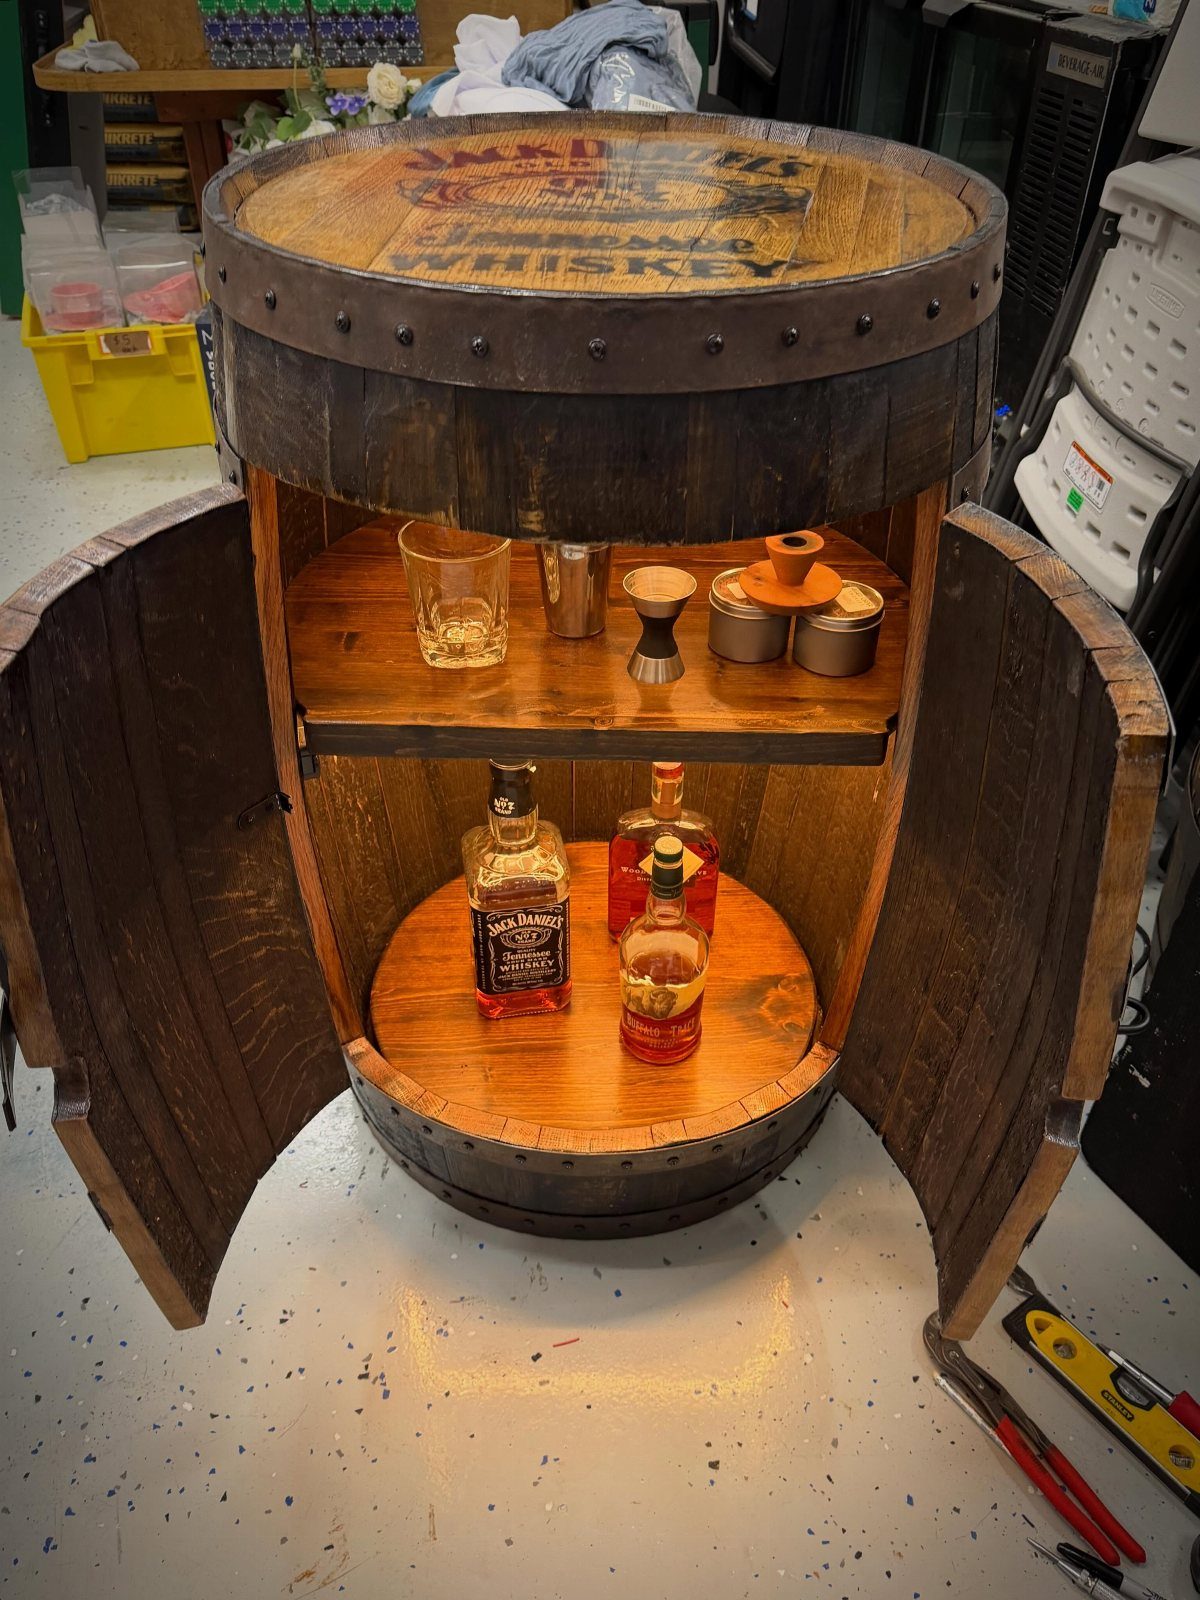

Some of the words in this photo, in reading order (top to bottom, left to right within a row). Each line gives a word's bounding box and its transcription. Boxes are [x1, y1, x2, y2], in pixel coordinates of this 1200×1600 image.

[404, 143, 566, 171] JACK
[389, 253, 790, 277] WHISKEY
[487, 916, 518, 937] JACK
[517, 913, 564, 930] DANIEL'S
[500, 959, 555, 972] WHISKEY
[502, 950, 551, 961] Tennessee
[627, 1012, 660, 1037] BUFFALO
[671, 1018, 696, 1038] TRACE
[1103, 1391, 1133, 1419] STANLEY
